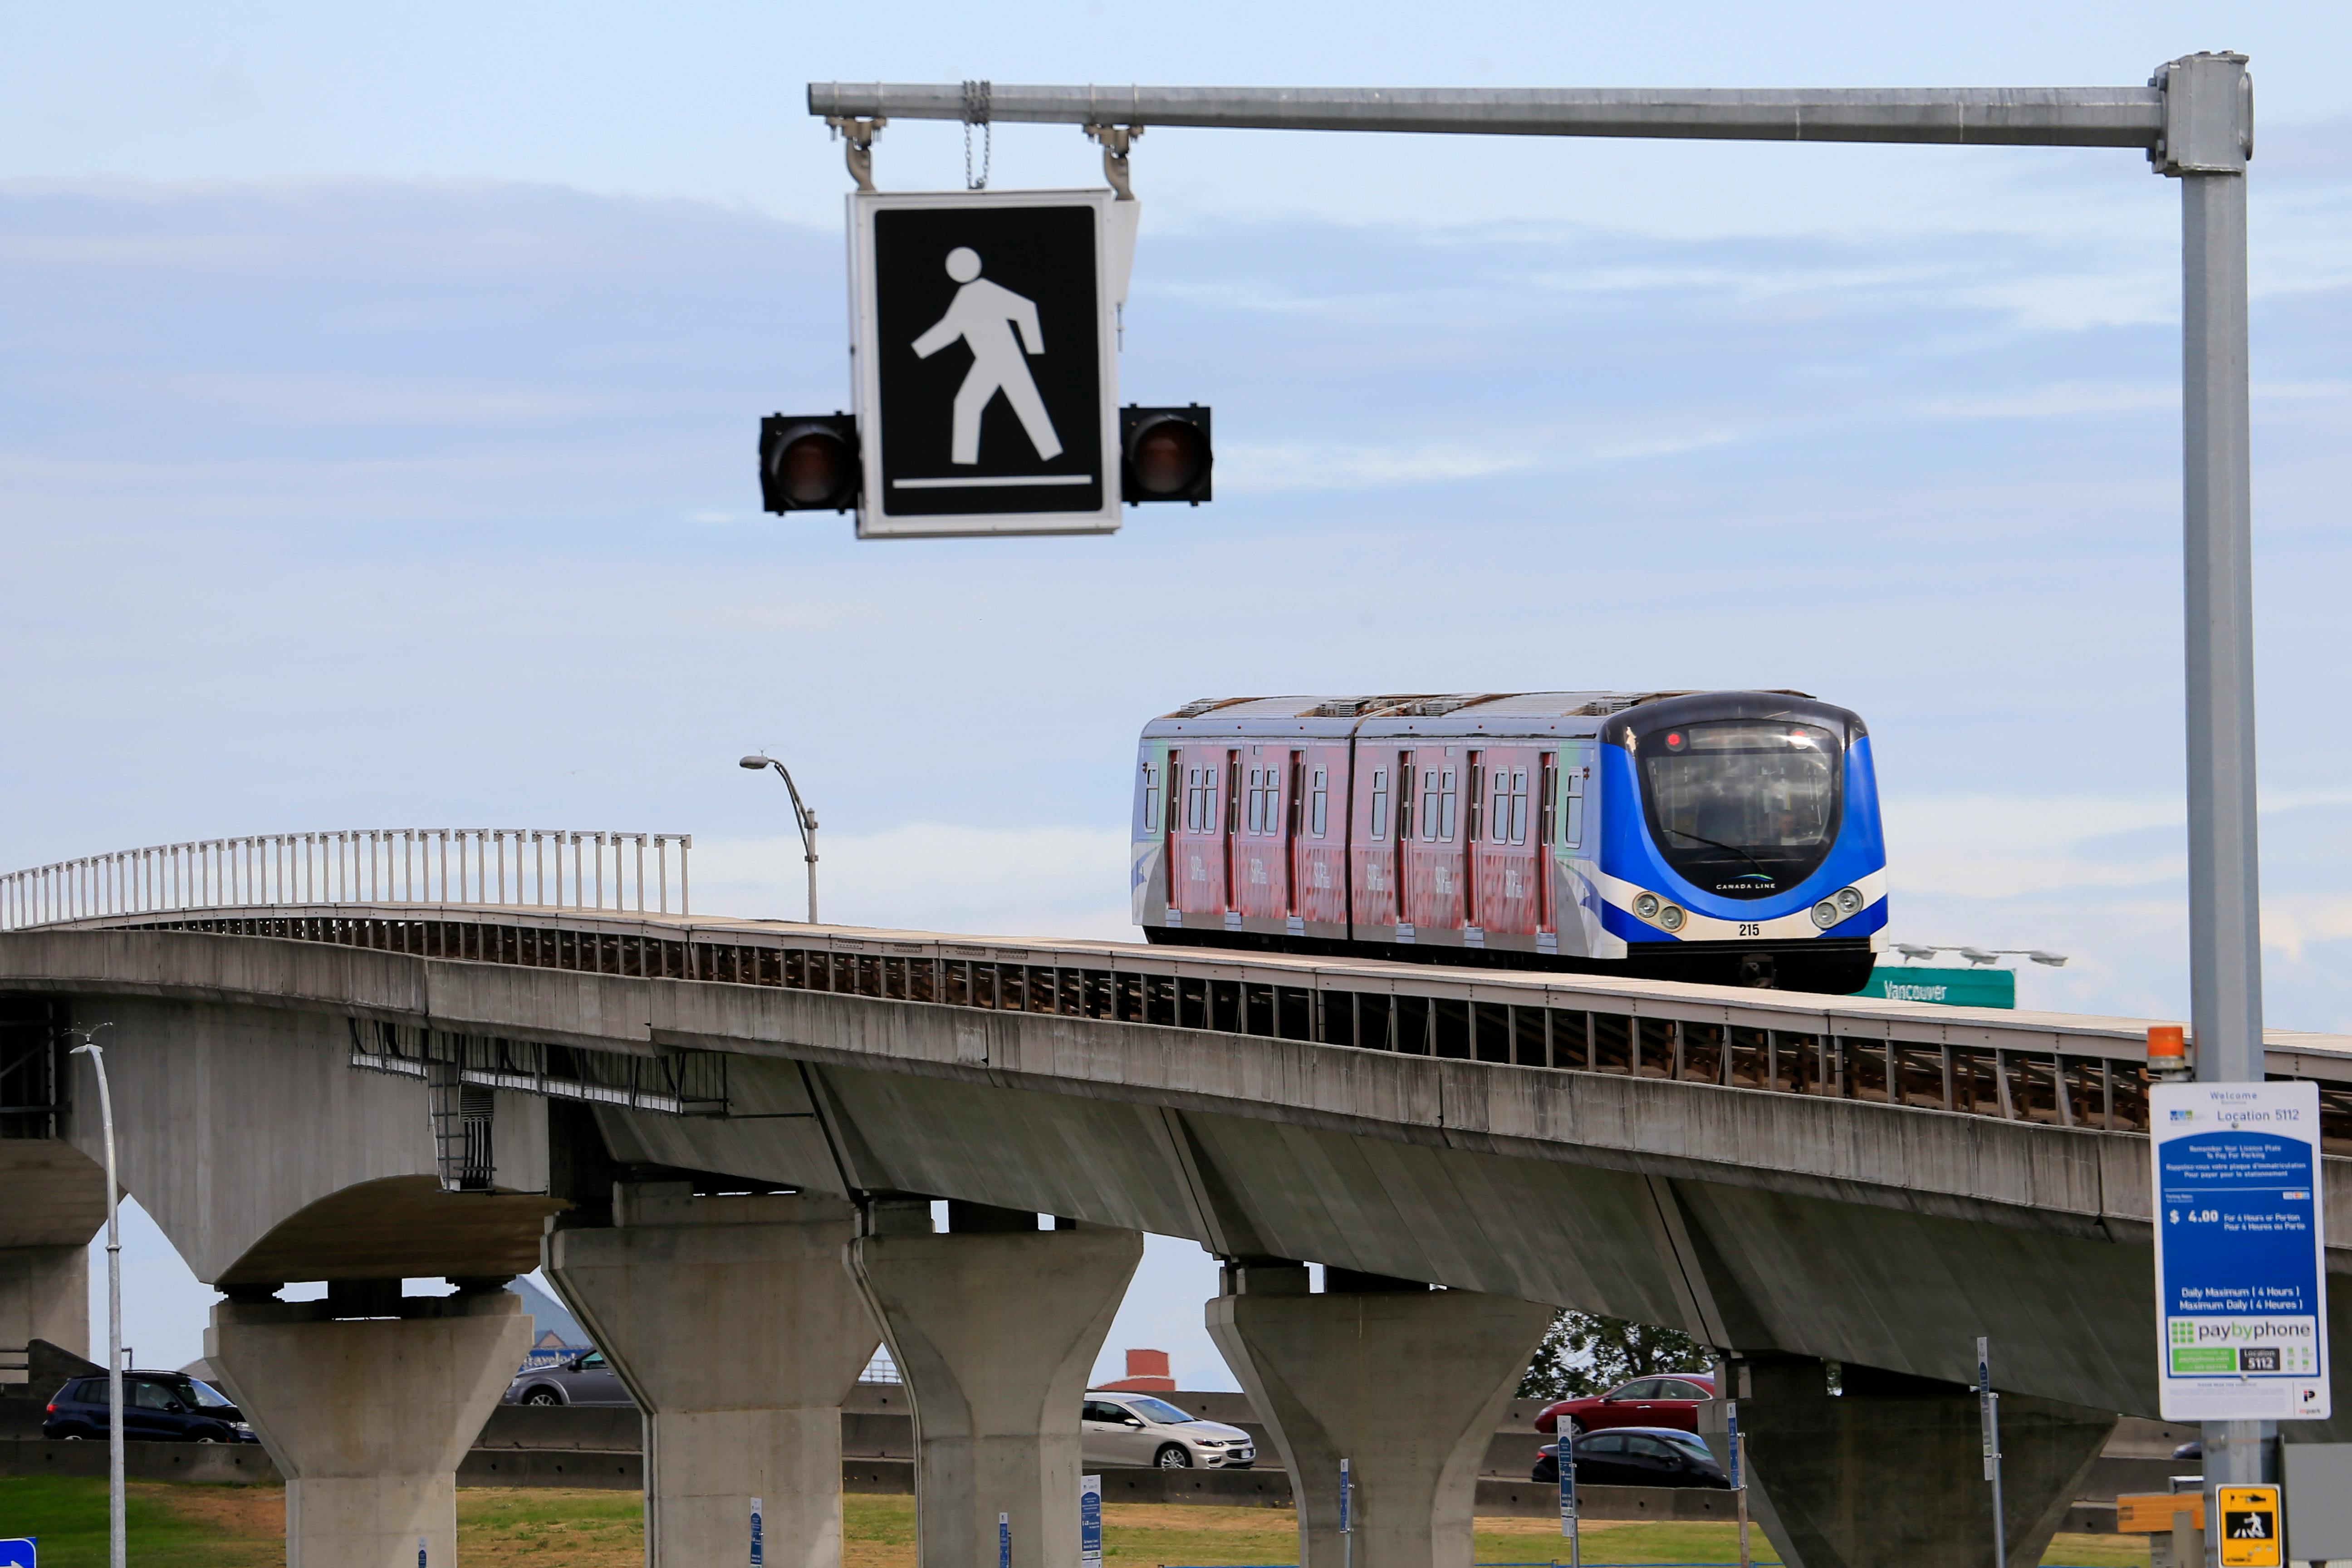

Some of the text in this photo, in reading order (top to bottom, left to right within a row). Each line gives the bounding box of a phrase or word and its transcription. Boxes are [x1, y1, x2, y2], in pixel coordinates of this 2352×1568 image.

[1739, 924, 1759, 936] 215
[1883, 980, 1947, 1001] Vancouver
[2210, 1091, 2258, 1100] Welcome
[2217, 1110, 2270, 1122] Location
[2275, 1109, 2299, 1121] 5112
[2264, 1144, 2282, 1152] Plate
[2215, 1152, 2227, 1161] Pay
[2240, 1152, 2266, 1160] Parking
[2169, 1209, 2219, 1225] $ 4.00
[2224, 1213, 2236, 1222] For
[2243, 1213, 2264, 1222] Hours
[2181, 1287, 2204, 1301] Daily
[2205, 1287, 2250, 1298] Maximum
[2266, 1286, 2294, 1297] Hours
[2179, 1300, 2225, 1311] Maximum
[2226, 1299, 2248, 1312] Daily
[2264, 1299, 2297, 1310] Heures
[2199, 1321, 2310, 1341] paybyphone
[2248, 1357, 2274, 1370] 5112
